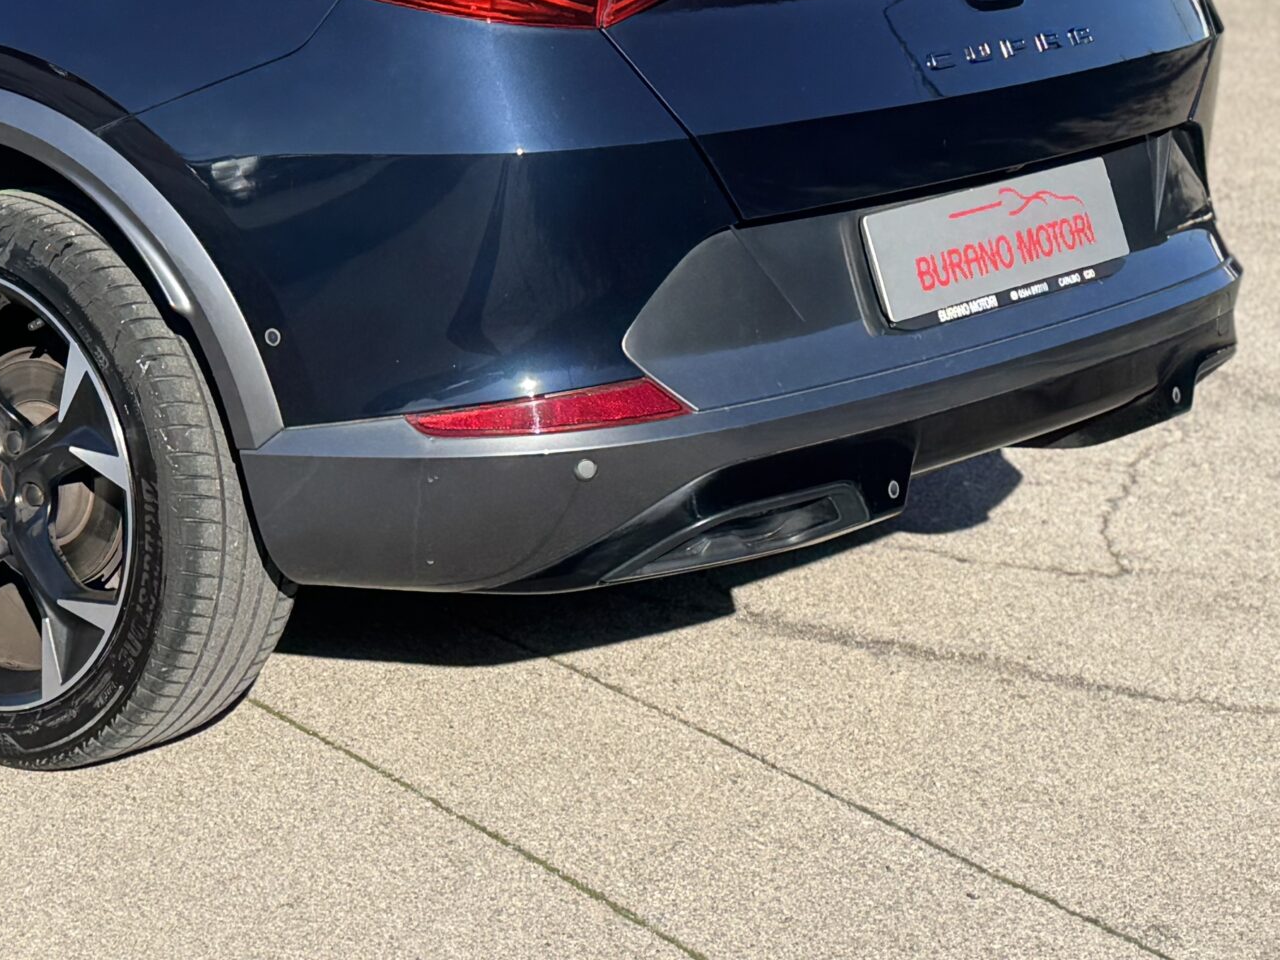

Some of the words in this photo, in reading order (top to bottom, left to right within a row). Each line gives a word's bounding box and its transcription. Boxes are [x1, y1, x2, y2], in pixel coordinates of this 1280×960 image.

[926, 26, 1095, 71] CUPRA
[915, 237, 1015, 291] BURANO
[1016, 212, 1097, 265] MOTORI
[938, 301, 970, 323] BURANO
[970, 295, 999, 315] MOTORI
